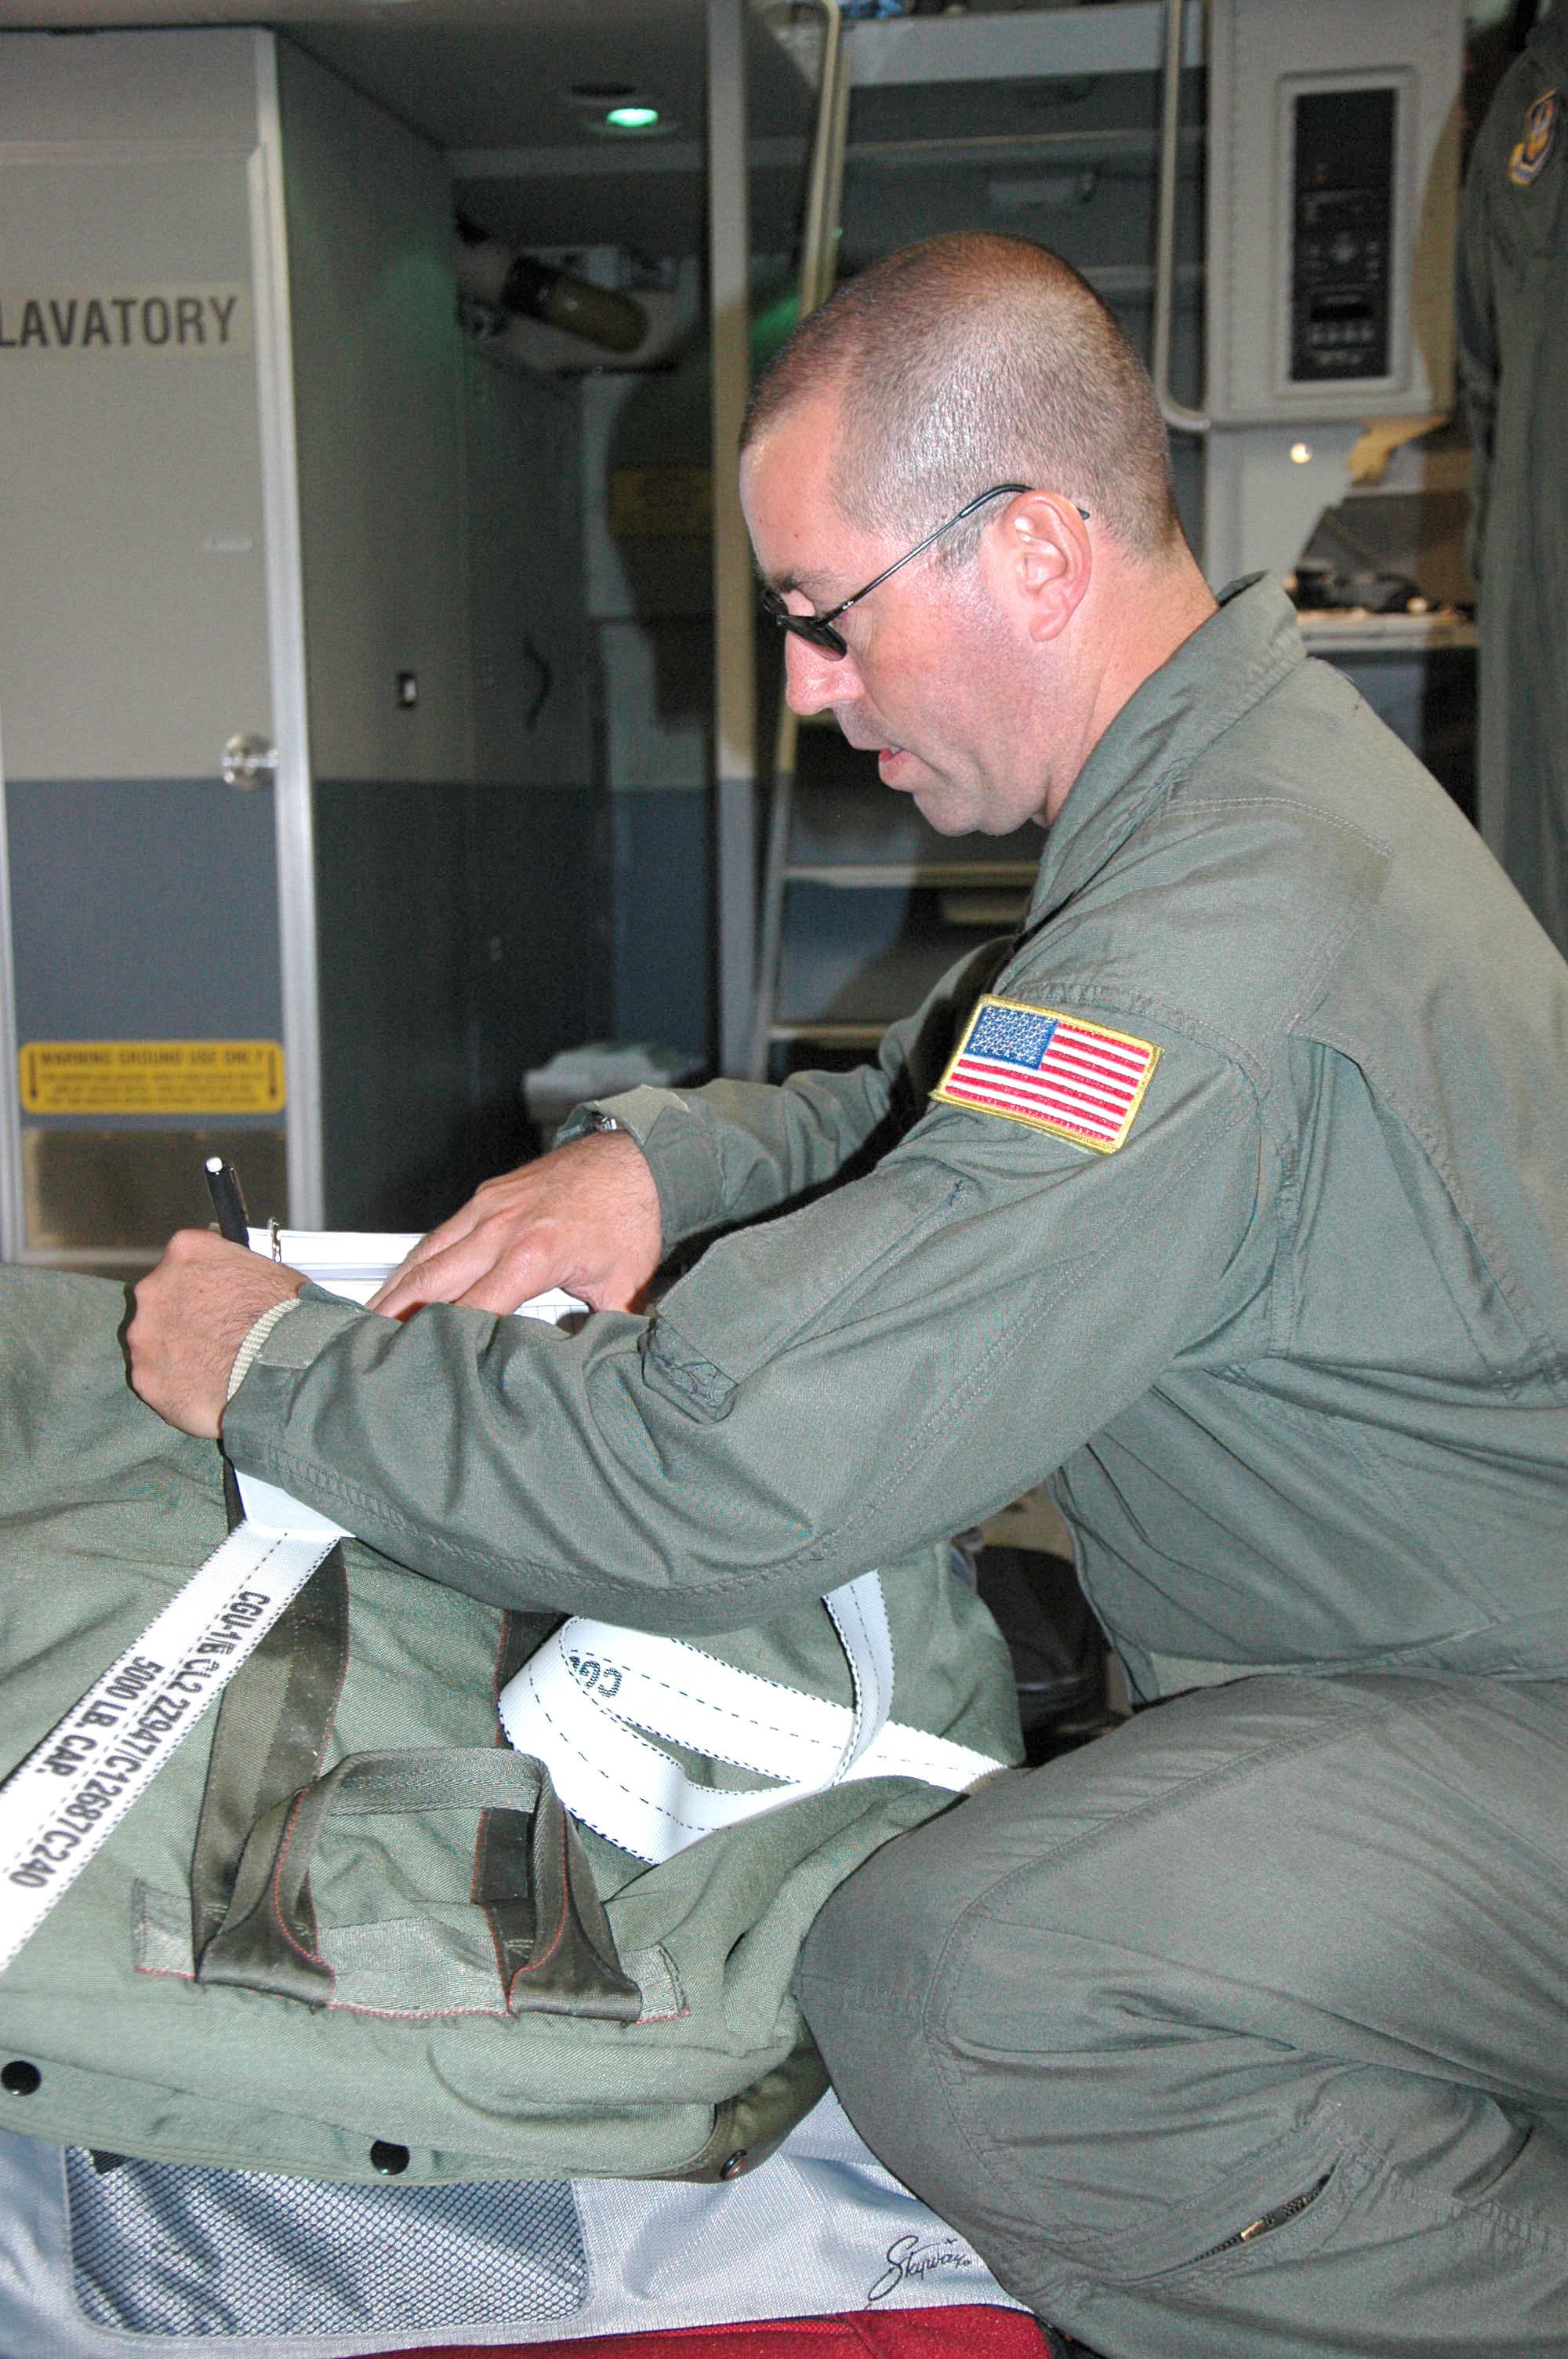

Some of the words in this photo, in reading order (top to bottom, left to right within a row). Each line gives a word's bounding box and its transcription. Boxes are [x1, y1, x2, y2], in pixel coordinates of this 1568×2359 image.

[0, 296, 237, 347] LAVATORY
[105, 1656, 165, 1701] 5000
[74, 1699, 127, 1728] LB.
[34, 1734, 98, 1778] CAP.
[868, 2235, 966, 2302] Skyway
